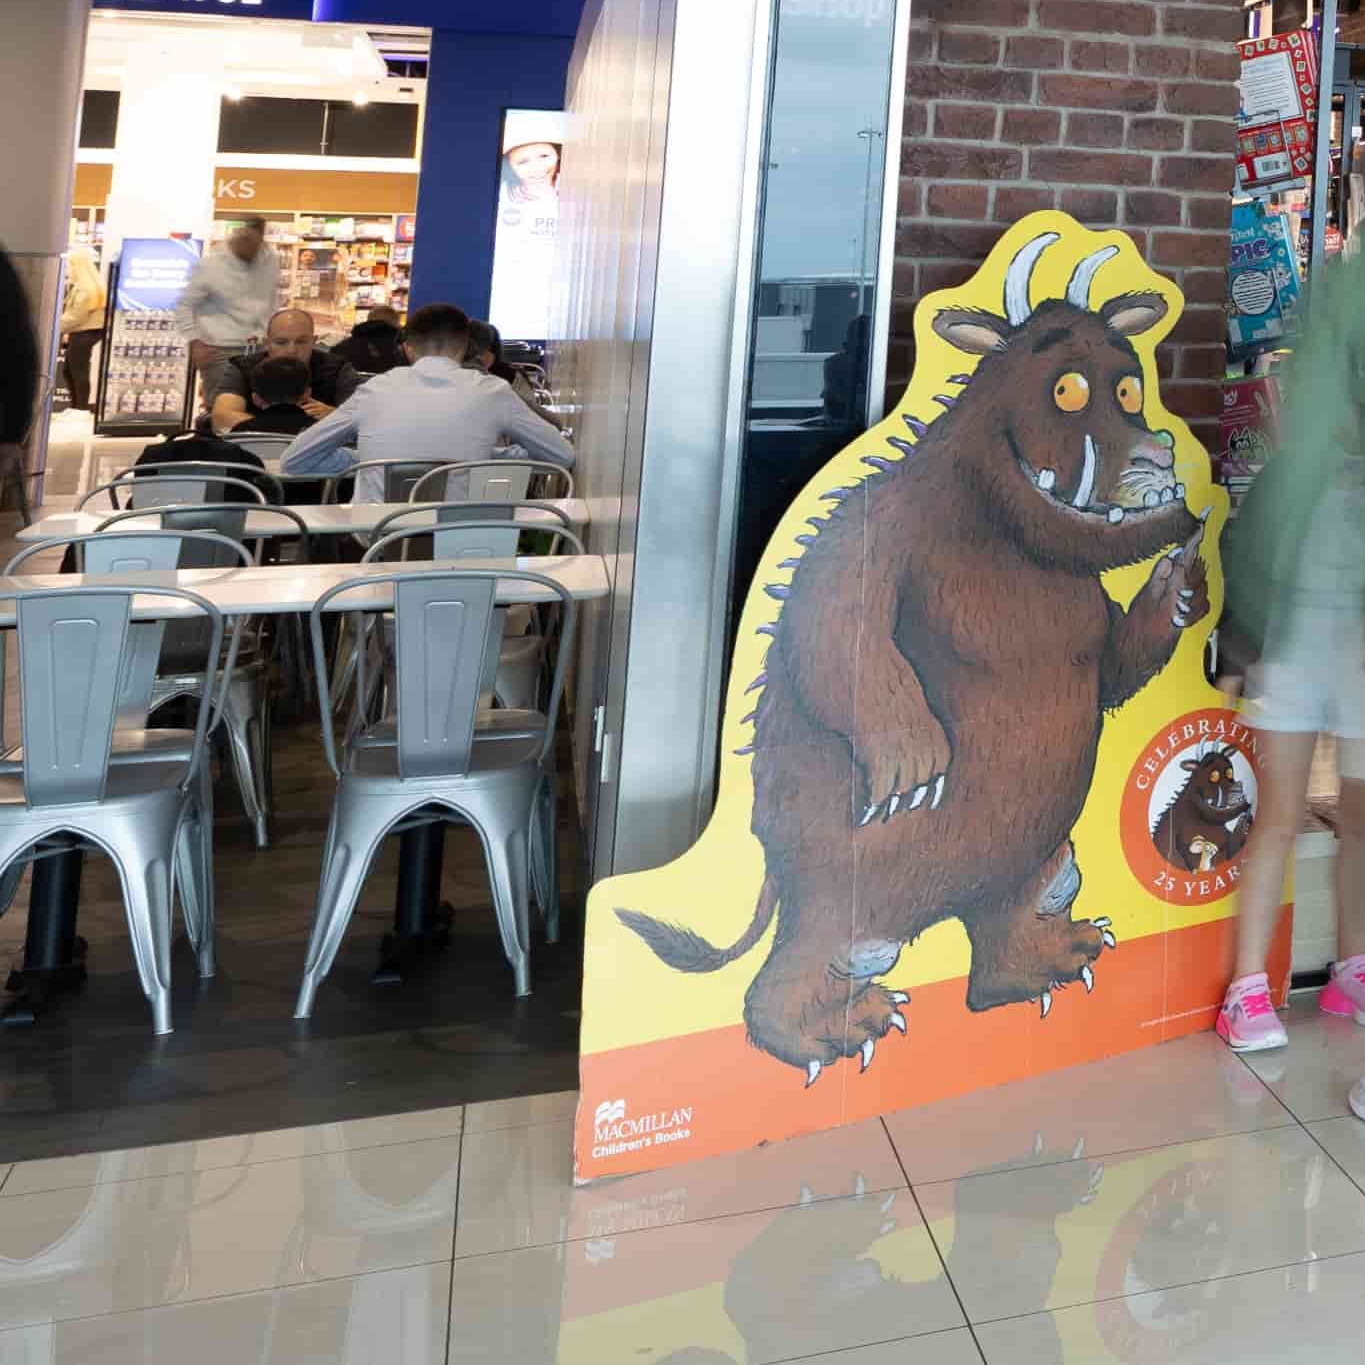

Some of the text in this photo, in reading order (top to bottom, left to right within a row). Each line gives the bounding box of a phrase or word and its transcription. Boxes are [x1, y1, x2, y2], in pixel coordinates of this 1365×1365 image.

[1153, 858, 1249, 896] 25 YEAR
[591, 1128, 691, 1159] Children's Books
[594, 1106, 693, 1144] MACMILLAN
